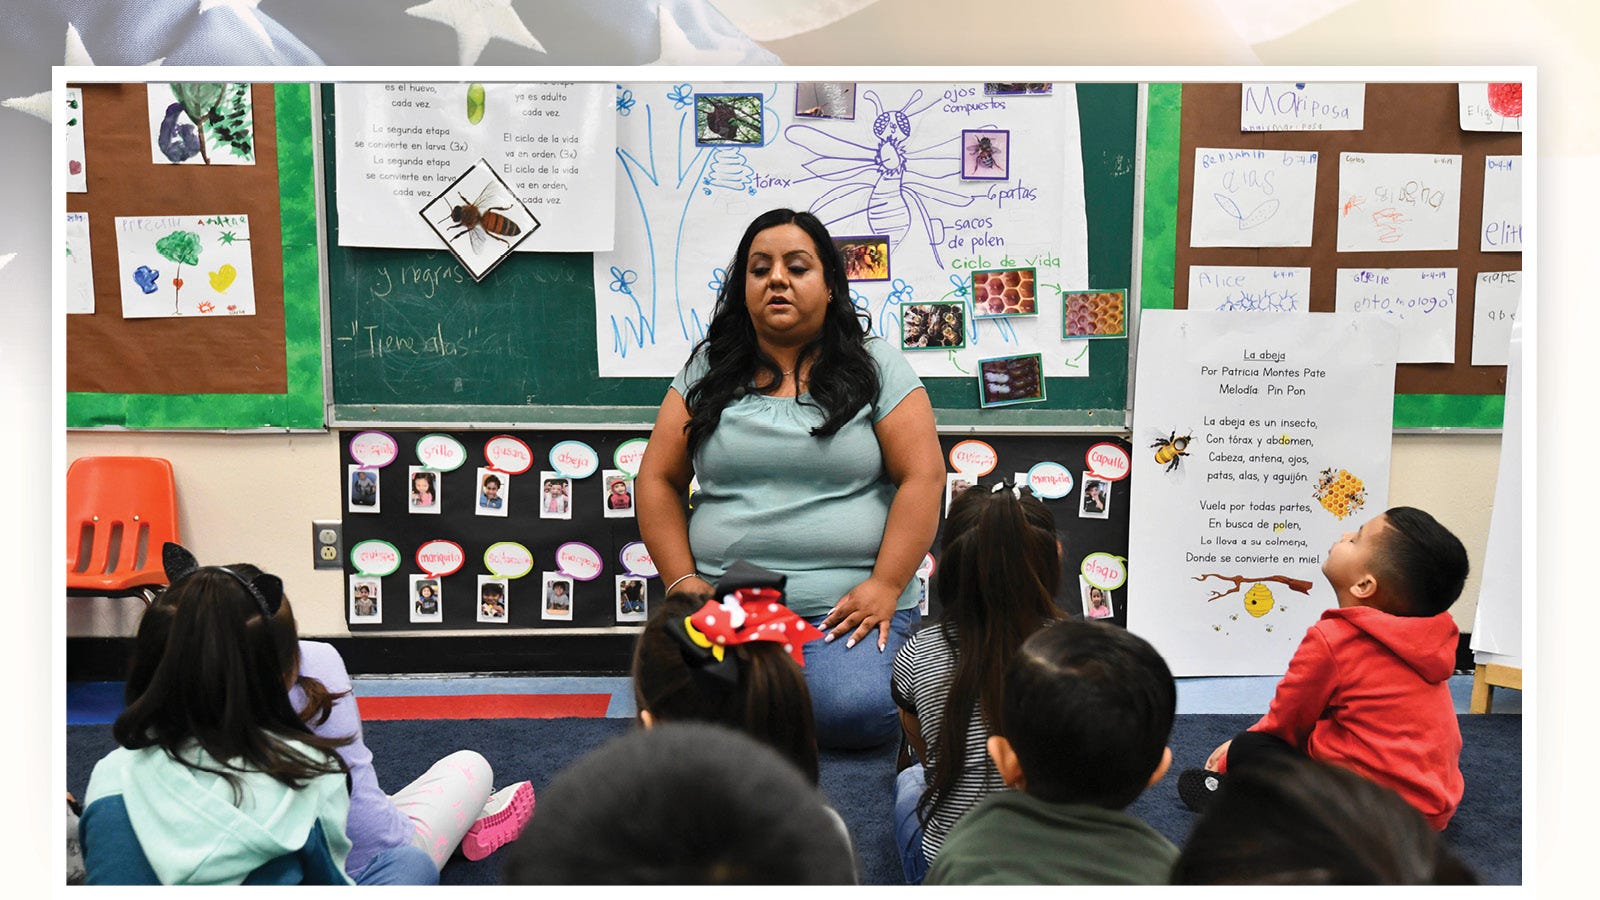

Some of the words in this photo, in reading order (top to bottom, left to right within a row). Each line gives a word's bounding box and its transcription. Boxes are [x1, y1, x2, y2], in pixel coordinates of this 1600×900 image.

[384, 84, 396, 92] es
[398, 84, 407, 92] el
[409, 84, 438, 94] huevo,
[943, 86, 976, 103] ojos
[391, 98, 413, 108] cada
[514, 93, 525, 103] ya
[541, 92, 568, 102] adulto
[1246, 86, 1349, 119] Mariposa
[522, 107, 543, 117] cada
[943, 98, 1006, 116] compuestos
[372, 124, 384, 134] La
[386, 126, 423, 137] segunda
[425, 126, 451, 138] etapa
[503, 132, 512, 143] El
[515, 133, 535, 143] ciclo
[538, 133, 549, 144] de
[551, 134, 559, 144] la
[562, 134, 579, 144] vida
[354, 141, 365, 149] se
[368, 141, 408, 151] convierte
[411, 143, 423, 151] en
[373, 155, 384, 165] La
[387, 157, 424, 168] segunda
[426, 157, 451, 169] etapa
[505, 151, 515, 159] va
[517, 151, 529, 159] en
[503, 163, 512, 174] El
[515, 164, 535, 174] ciclo
[538, 164, 549, 175] de
[551, 165, 560, 175] la
[562, 165, 579, 175] vida
[366, 172, 376, 180] se
[379, 172, 420, 182] convierte
[422, 174, 434, 182] en
[754, 172, 791, 189] tórax
[393, 187, 414, 197] cada
[516, 182, 526, 190] va
[528, 182, 540, 190] en
[522, 195, 543, 205] cada
[987, 183, 997, 200] 6
[999, 179, 1037, 209] patas
[954, 217, 993, 230] sacos
[948, 236, 966, 249] de
[970, 230, 1005, 255] polen
[951, 255, 991, 270] ciclo
[999, 254, 1017, 268] de
[1199, 272, 1246, 288] Alice
[1243, 349, 1256, 361] La
[1259, 349, 1286, 363] abeja
[1201, 366, 1218, 376] Por
[1221, 366, 1259, 377] Patricia
[1262, 367, 1300, 378] Montes
[1303, 368, 1326, 378] Pate
[1267, 384, 1284, 396] Pin
[1287, 385, 1306, 396] Pon
[1203, 416, 1216, 426] La
[1219, 416, 1246, 430] abeja
[1264, 420, 1277, 428] un
[1280, 418, 1318, 430] insecto,
[1206, 433, 1225, 445] Con
[1228, 434, 1253, 445] tórax
[1257, 437, 1263, 448] y
[1266, 435, 1314, 448] abdomen,
[557, 451, 590, 469] abeja
[1208, 451, 1246, 464] Cabeza,
[1248, 453, 1285, 465] antena,
[1288, 455, 1310, 467] ojos,
[1207, 470, 1236, 483] patas,
[1238, 470, 1260, 483] alas,
[1263, 473, 1269, 484] y
[1199, 500, 1226, 511] Vuela
[1229, 504, 1246, 514] por
[1249, 501, 1276, 512] todas
[1279, 502, 1313, 515] partes,
[1208, 518, 1222, 529] En
[1225, 518, 1254, 529] busca
[1256, 518, 1270, 529] de
[1273, 519, 1302, 533] polen,
[1200, 536, 1213, 546] Lo
[1185, 552, 1217, 563] Donde
[1220, 555, 1232, 563] se
[1234, 553, 1280, 565] convierte
[1282, 556, 1295, 564] en
